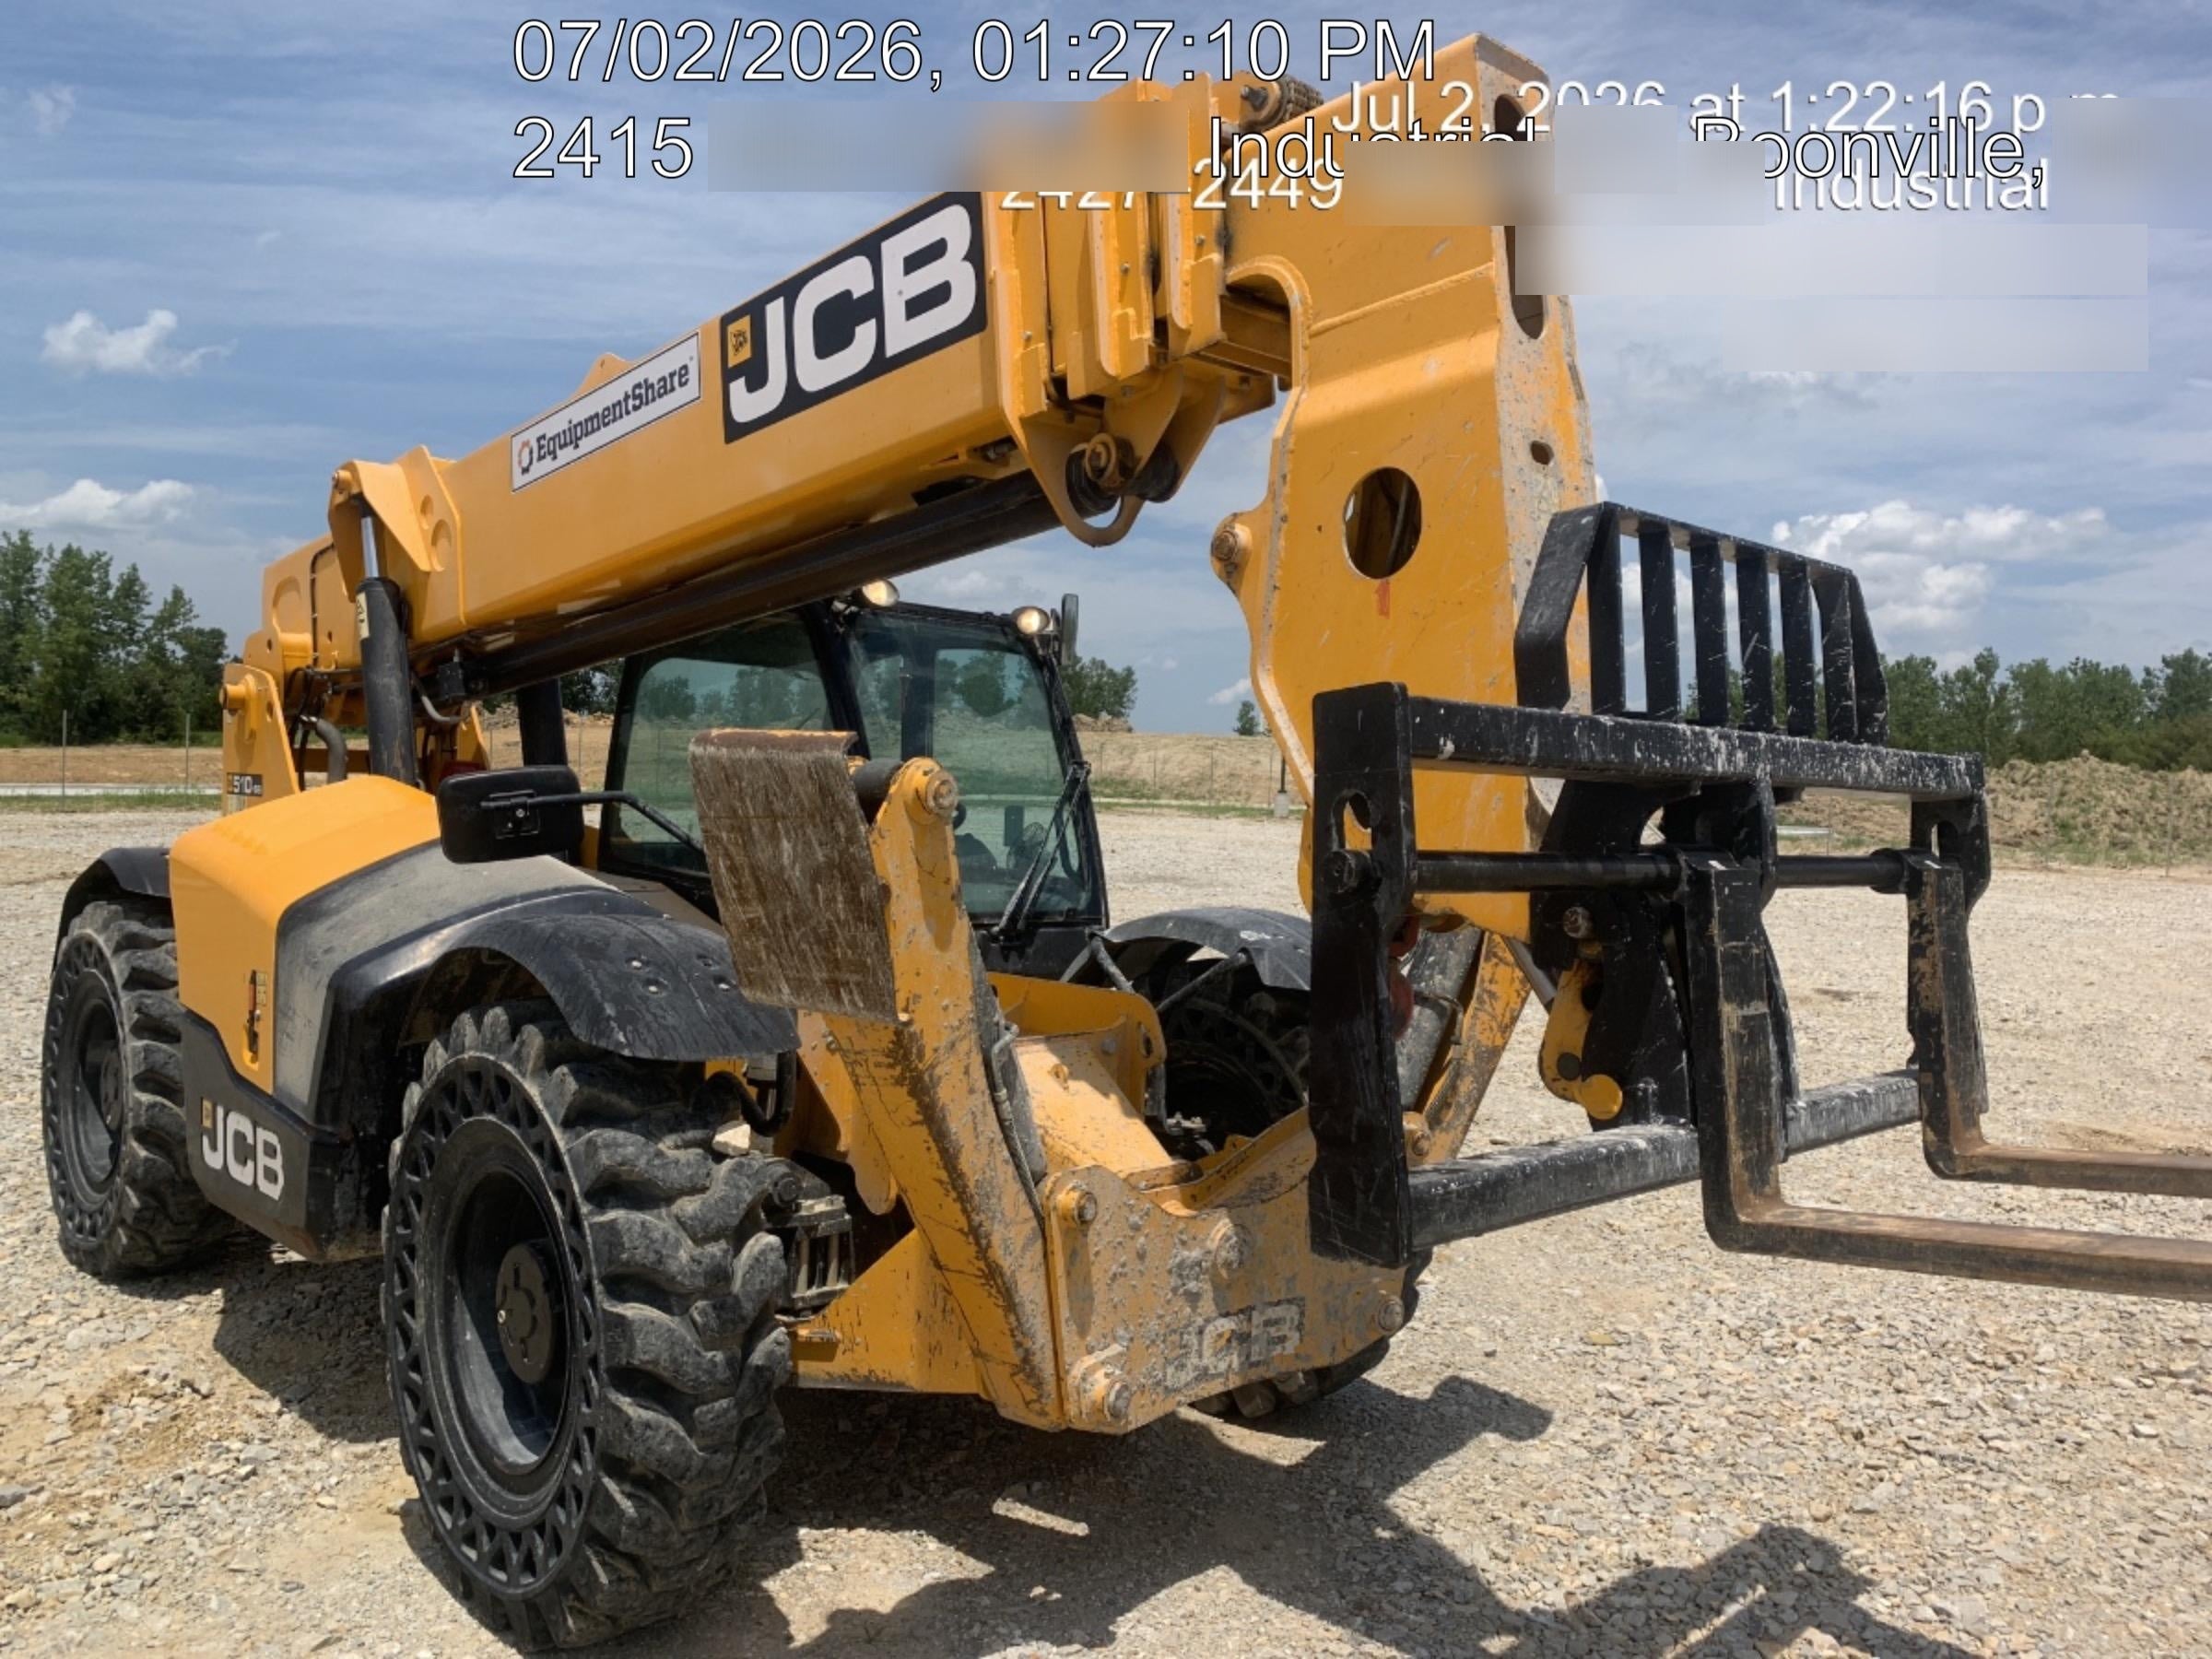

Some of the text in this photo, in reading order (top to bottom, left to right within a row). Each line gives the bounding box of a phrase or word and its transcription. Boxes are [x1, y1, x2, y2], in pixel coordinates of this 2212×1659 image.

[729, 204, 977, 423] JCB
[536, 363, 690, 462] EquipmentShare
[202, 1104, 285, 1201] JCB
